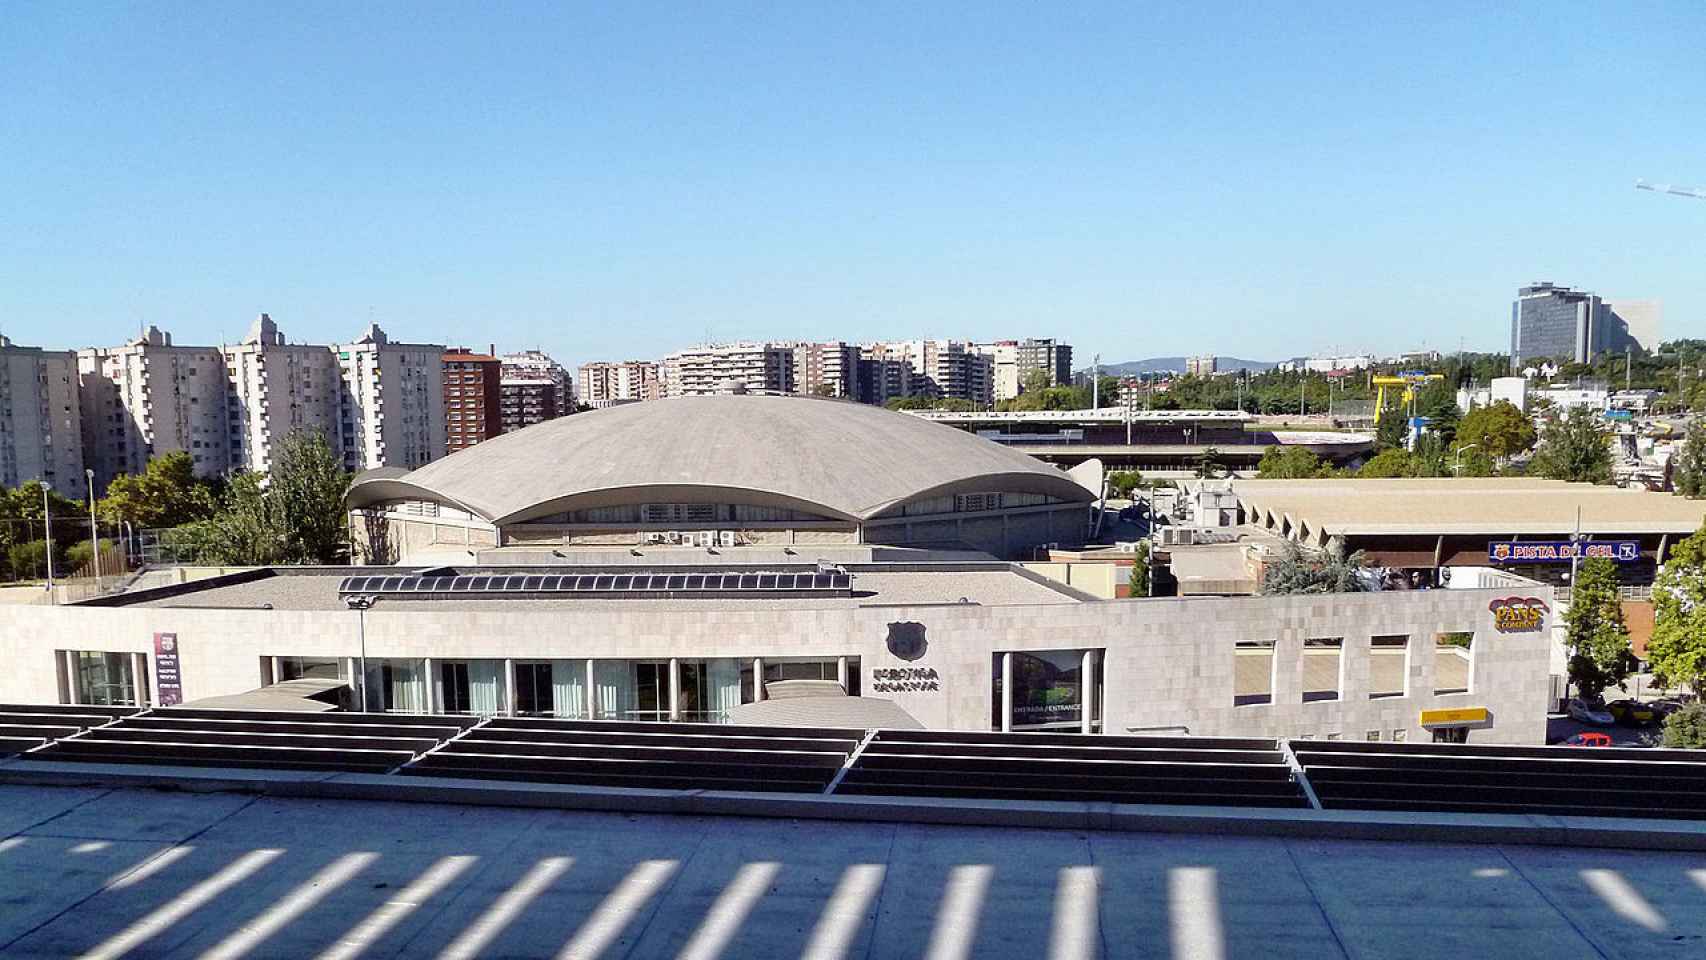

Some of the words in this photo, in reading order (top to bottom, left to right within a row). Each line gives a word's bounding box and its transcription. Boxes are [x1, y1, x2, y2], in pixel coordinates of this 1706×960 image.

[1513, 545, 1557, 559] PISTA
[1585, 545, 1614, 558] GEL
[1496, 607, 1539, 621] PANS
